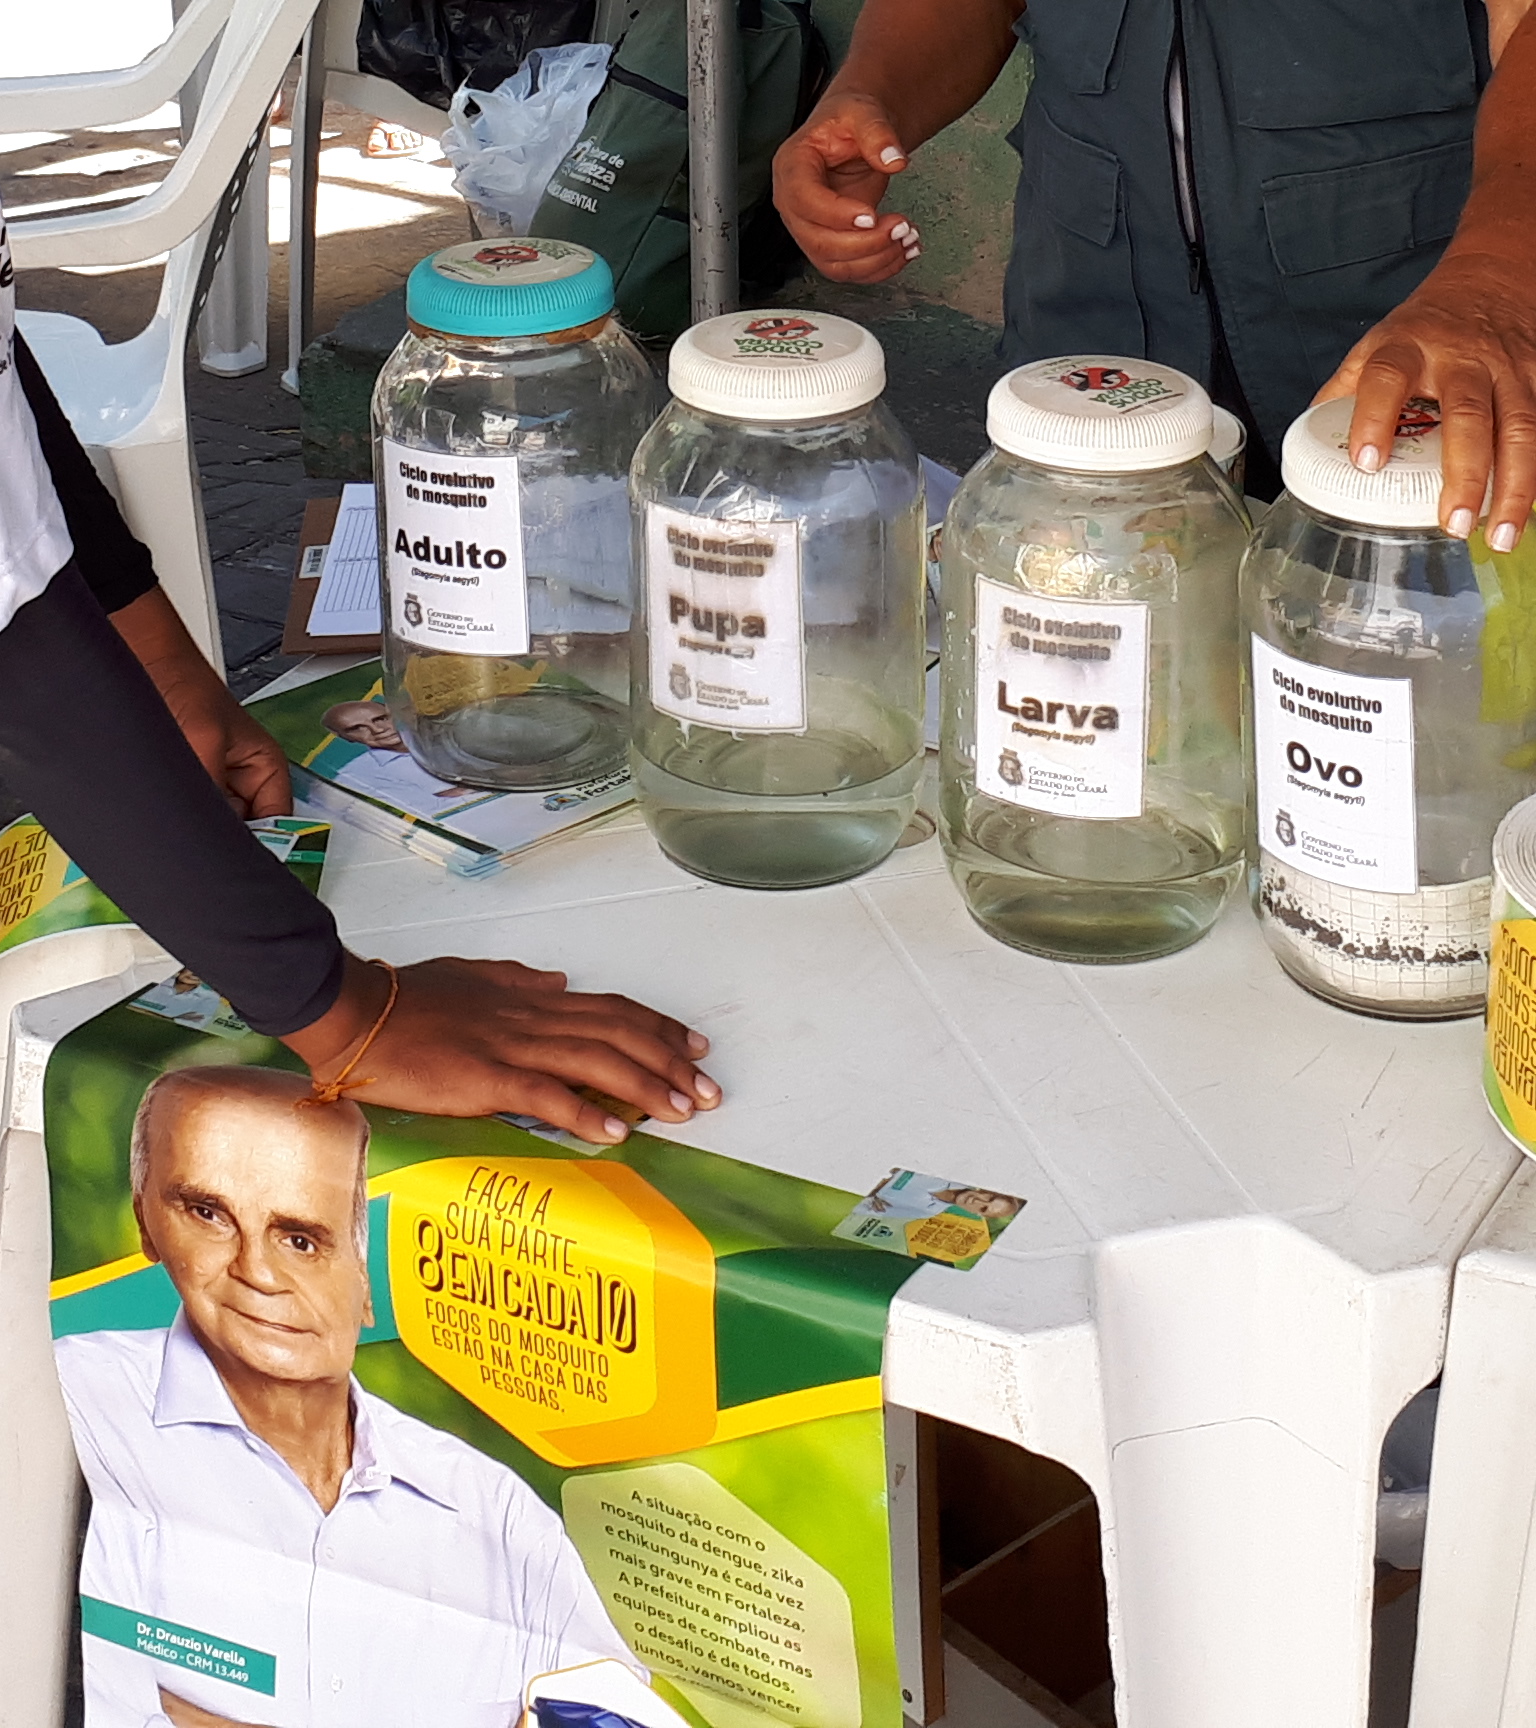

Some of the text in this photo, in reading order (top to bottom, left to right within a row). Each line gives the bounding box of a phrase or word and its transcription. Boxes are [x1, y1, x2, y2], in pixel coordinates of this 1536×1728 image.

[400, 461, 495, 489] Ciclo evolutivo
[406, 484, 487, 508] do mosquito
[395, 528, 507, 569] Adulto
[670, 594, 766, 642] Pupa
[997, 680, 1119, 730] Larva
[1273, 668, 1382, 714] Ciclo evolutivo
[1280, 694, 1373, 733] do mosquito
[1286, 741, 1363, 787] Ovo
[464, 1166, 553, 1225] FAÇA A
[445, 1202, 582, 1279] SUA PARTE.
[413, 1213, 637, 1353] 8 EM CADA 10
[425, 1297, 609, 1378] FOCOS DO MOSQUITO
[431, 1325, 608, 1404] ESTÃO NA CASA DAS
[480, 1364, 565, 1413] PESSOAS.
[600, 1501, 804, 1589] mosquito da dengue, zika
[631, 1490, 766, 1552] A situação com o
[605, 1525, 805, 1611] e chikungunya é cada vez
[137, 1622, 245, 1666] Dr. Drauzio Varella
[137, 1638, 249, 1683] Médico CRM 13.449
